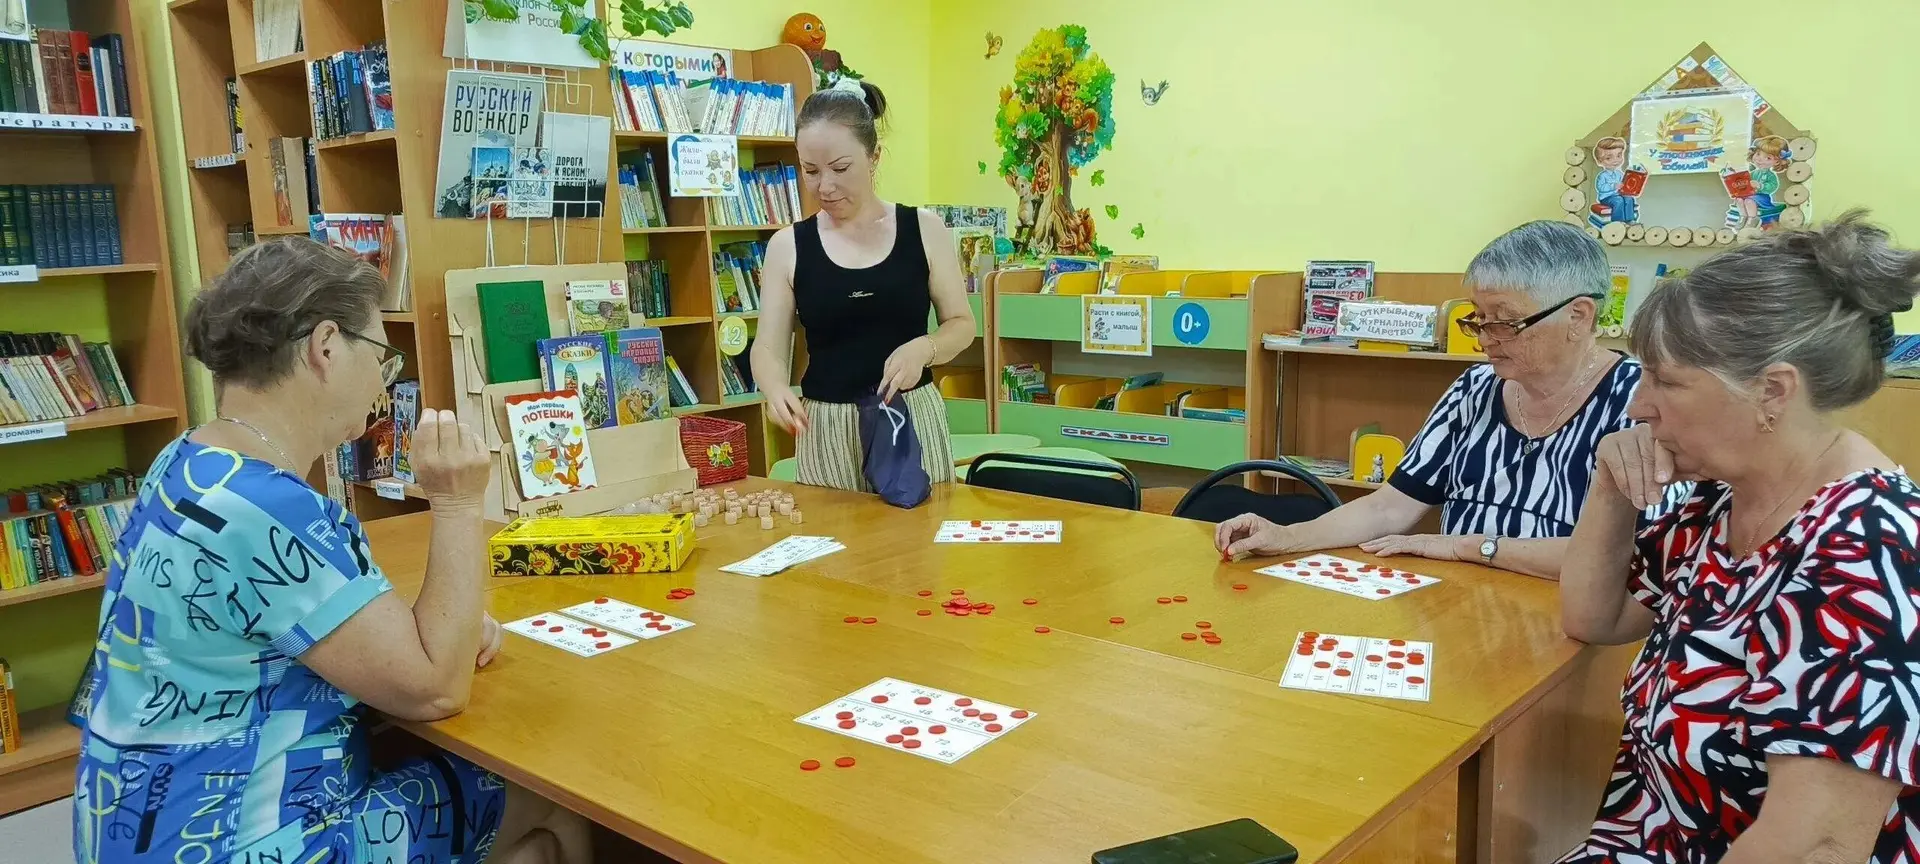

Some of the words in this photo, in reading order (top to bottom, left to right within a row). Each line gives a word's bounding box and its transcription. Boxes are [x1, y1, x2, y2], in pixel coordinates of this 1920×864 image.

[624, 51, 711, 72] которыми
[455, 86, 532, 112] РУССКИЙ
[0, 117, 131, 130] тература
[453, 110, 529, 135] ВОЕНКОР
[555, 156, 583, 166] ДОРОГА
[555, 167, 560, 176] К
[1090, 309, 1109, 317] Расти
[1116, 309, 1142, 318] книгой,
[1359, 307, 1423, 321] ОТКРЫВАЕМ
[1113, 323, 1138, 331] малыш
[1181, 312, 1201, 333] 0+
[1358, 319, 1424, 329] ЖУРНАЛЬНОЕ
[721, 325, 743, 346] 12
[1367, 326, 1414, 337] ЦАРСТВО
[558, 340, 593, 350] РУССКИЕ
[561, 349, 592, 359] СКАЗКИ
[527, 403, 541, 411] Мои
[521, 409, 574, 424] ПОТЕШКИ
[5, 428, 44, 438] романы
[1062, 428, 1167, 443] СКАЗКИ
[224, 525, 326, 641] ING
